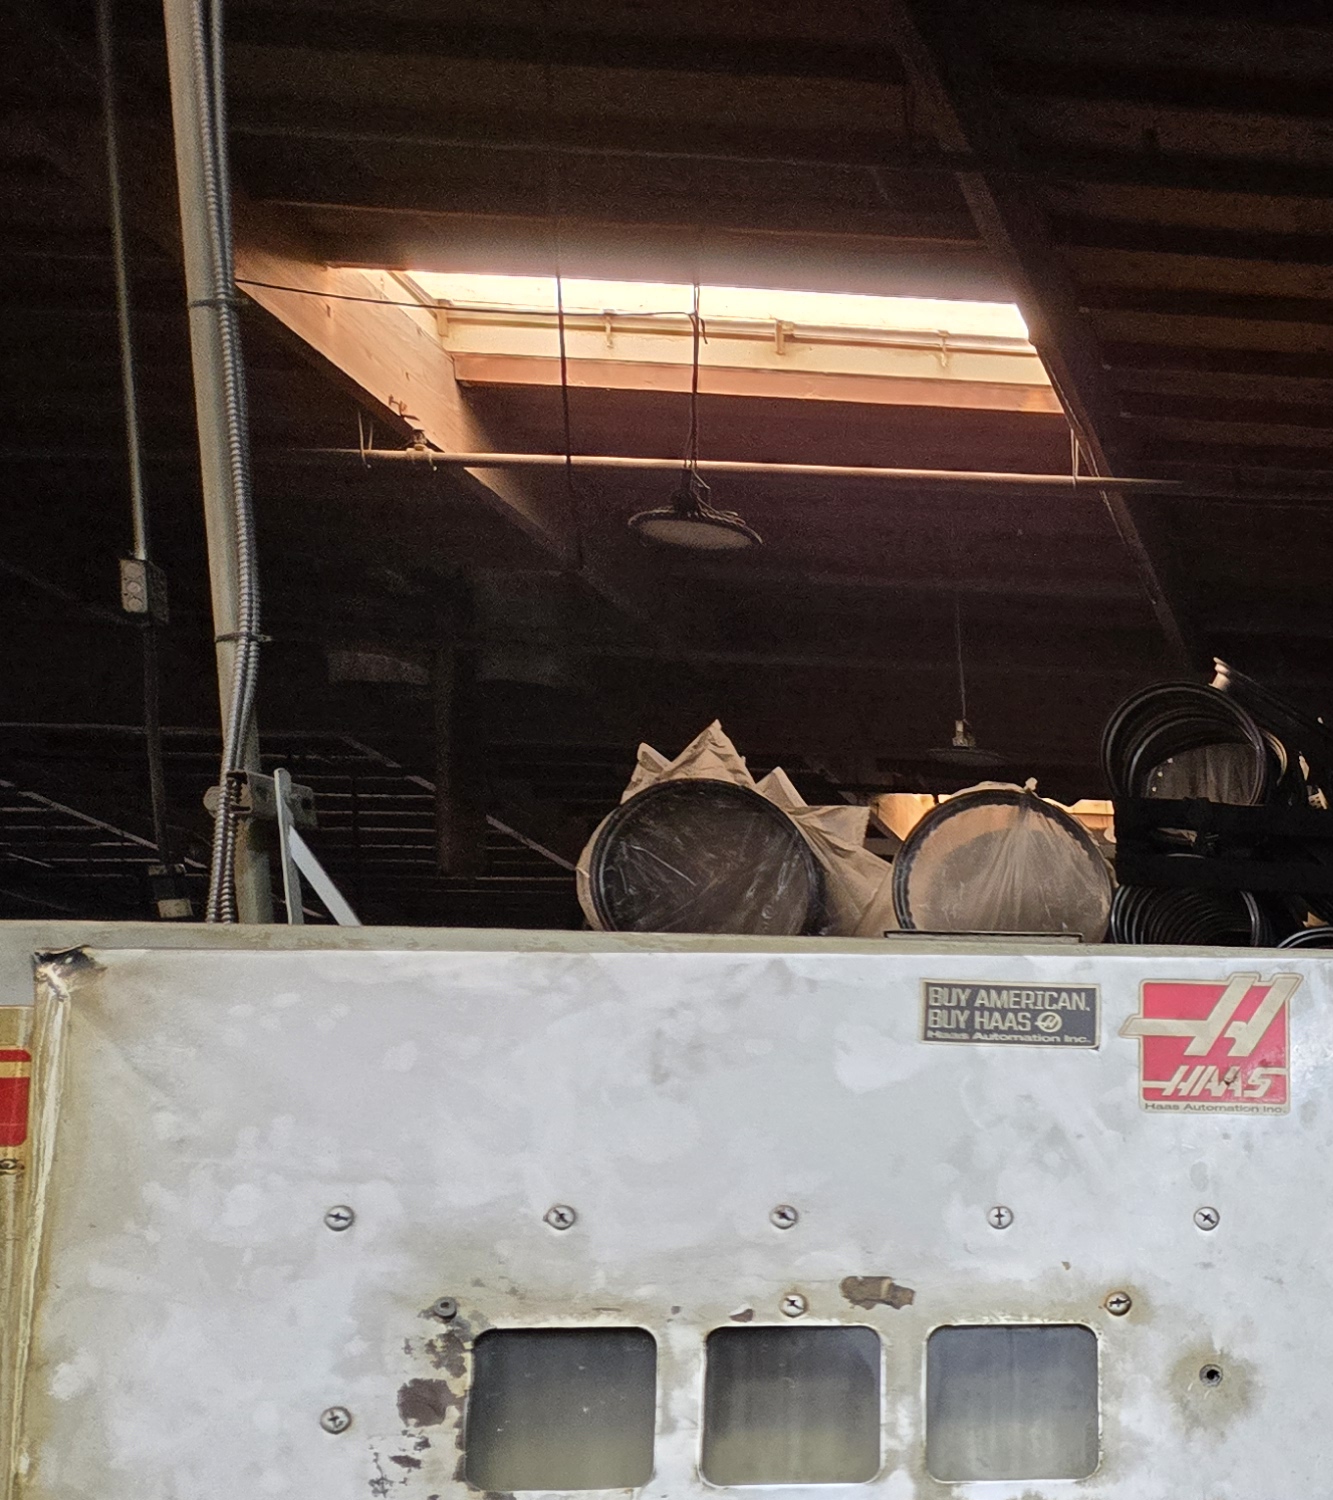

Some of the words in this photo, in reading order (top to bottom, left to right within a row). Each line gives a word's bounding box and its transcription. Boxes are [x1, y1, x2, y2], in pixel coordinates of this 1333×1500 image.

[928, 987, 971, 1006] BUY
[974, 989, 1091, 1011] AMERICAN.
[928, 1010, 971, 1028] BUY
[974, 1013, 1032, 1031] HAAS
[926, 1029, 970, 1040] Haas
[972, 1032, 1061, 1043] Automation
[1064, 1035, 1091, 1044] Inc.
[1143, 1065, 1287, 1097] HAAS
[1144, 1103, 1183, 1112] Haas
[1185, 1104, 1260, 1113] Automation
[1263, 1105, 1286, 1114] Inc.
